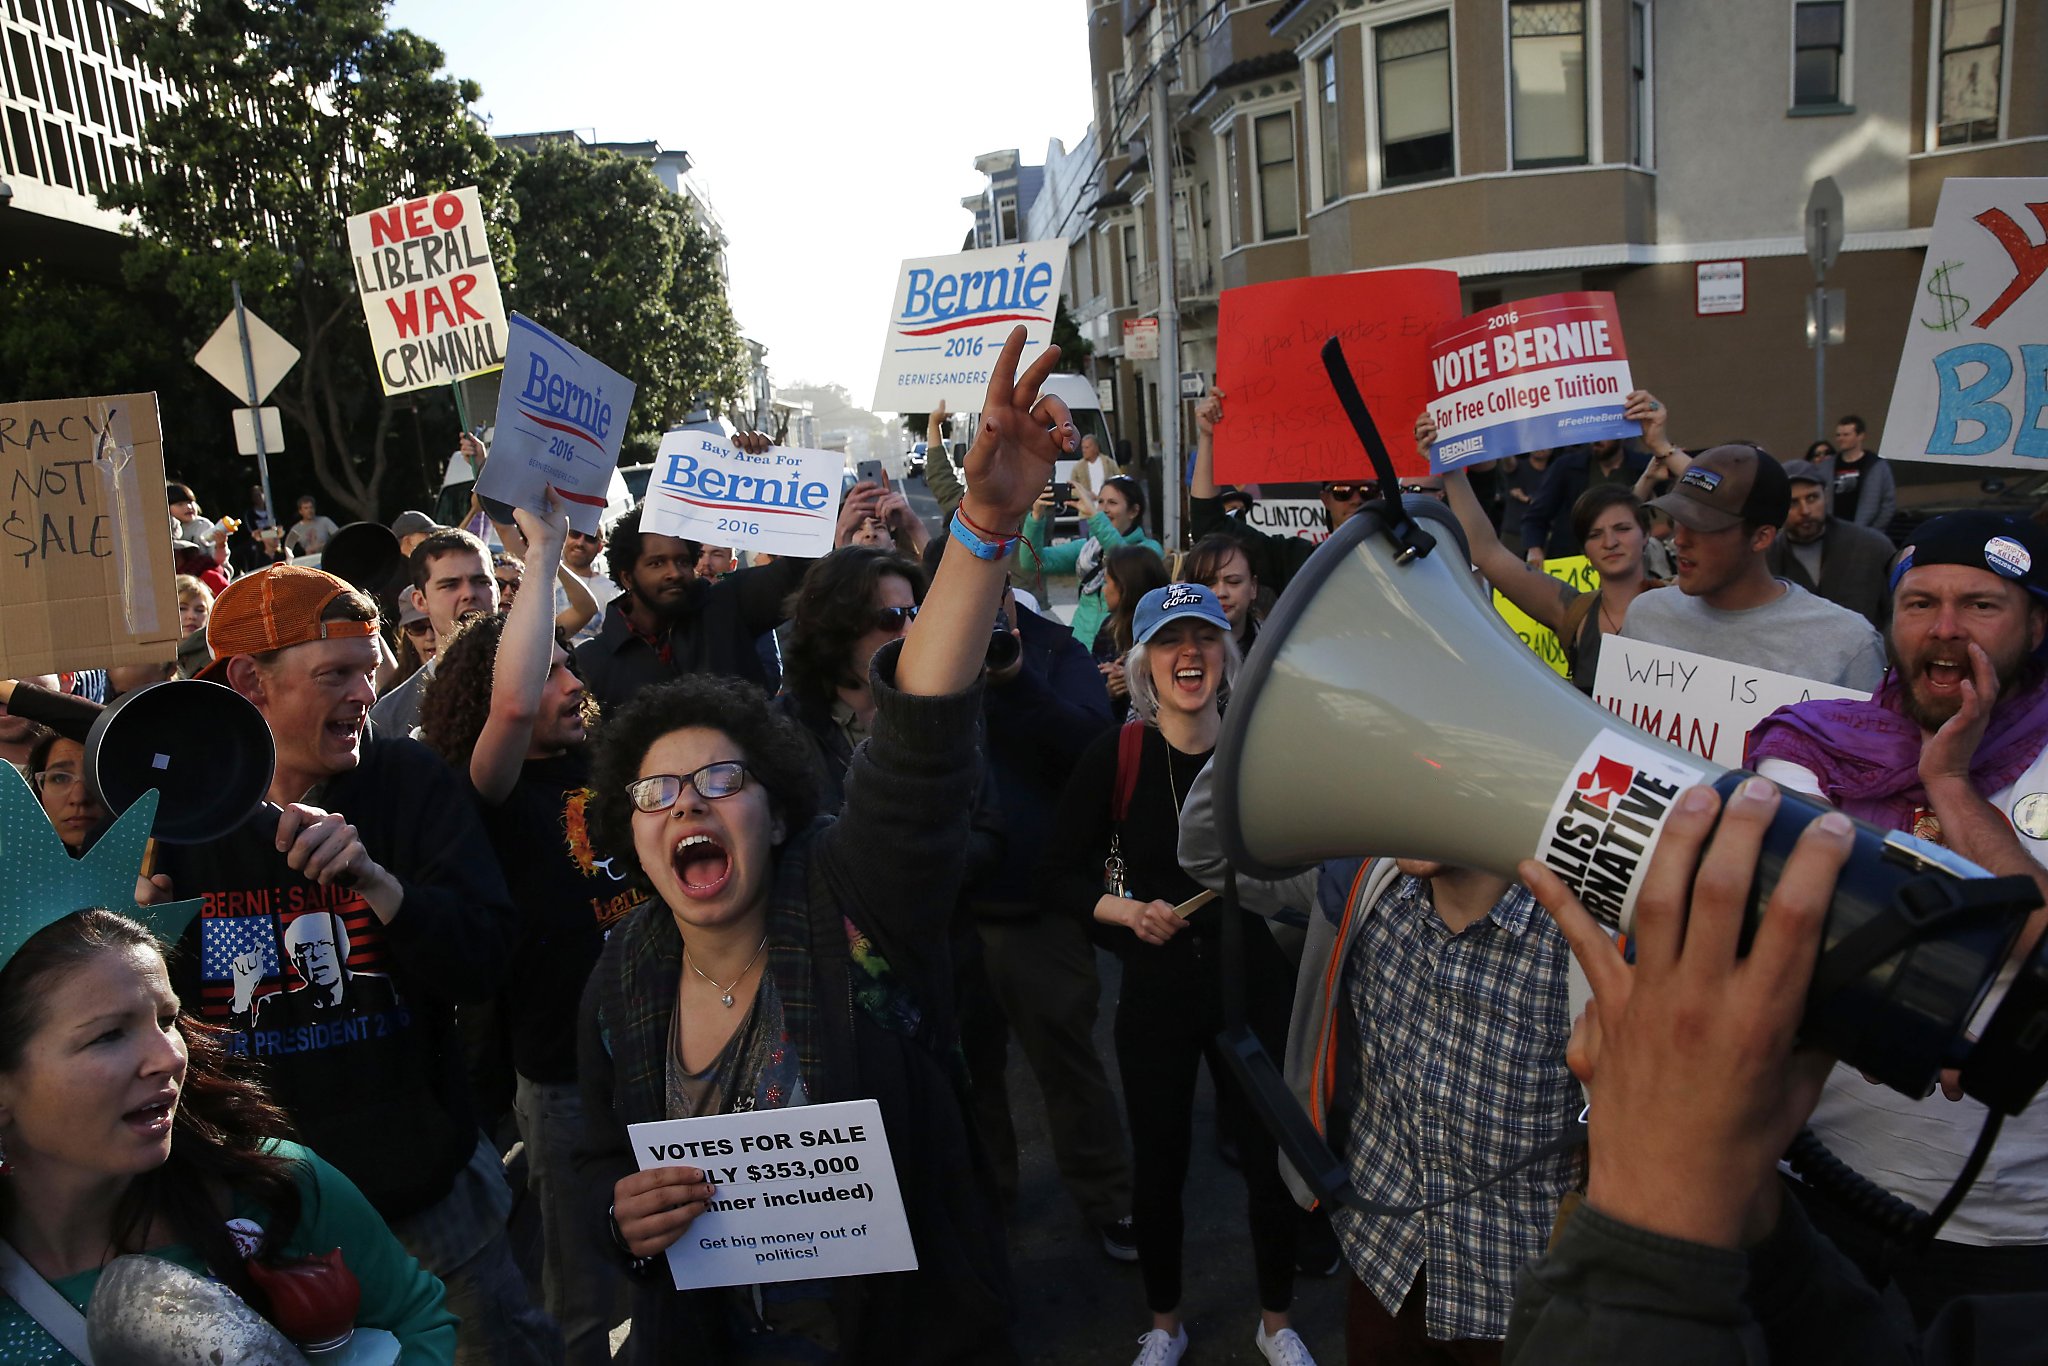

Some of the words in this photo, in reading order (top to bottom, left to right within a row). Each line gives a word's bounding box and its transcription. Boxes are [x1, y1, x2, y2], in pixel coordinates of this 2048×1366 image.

[369, 193, 464, 248] NEO
[355, 226, 489, 295] LIBERAL
[901, 250, 1052, 318] Bernie
[385, 274, 486, 339] WAR
[1487, 311, 1519, 331] 2016
[382, 322, 505, 388] CRIMINAL
[944, 336, 984, 357] 2016
[1432, 340, 1490, 393] VOTE
[1493, 320, 1613, 373] BERNIE
[898, 371, 989, 386] BERNIESANDERS.
[522, 351, 612, 440] Bernie
[1436, 408, 1454, 431] For
[1456, 401, 1485, 424] Free
[1487, 383, 1551, 414] College
[1555, 373, 1619, 400] Tuition
[1557, 412, 1623, 428] #FeeltheBern
[548, 436, 575, 462] 2016
[701, 440, 729, 458] Bay
[735, 451, 770, 465] Area
[776, 455, 803, 466] For
[1439, 435, 1484, 460] BERNIE!
[12, 460, 92, 505] NOT
[662, 454, 829, 510] Bernie
[717, 518, 759, 535] 2016
[1250, 502, 1326, 527] CLINTON
[1997, 549, 2020, 565] KILLER
[1168, 587, 1191, 598] THE
[1625, 653, 1698, 692] WHY
[1730, 675, 1758, 704] IS
[1583, 770, 1680, 929] ERNATIVE
[254, 1016, 369, 1057] PRESIDENT
[648, 1138, 734, 1162] VOTES
[740, 1133, 794, 1153] FOR
[800, 1125, 867, 1148] SALE
[702, 1167, 738, 1185] LY
[747, 1155, 860, 1184] $353,000
[706, 1196, 756, 1213] nner
[763, 1182, 874, 1208] included)
[699, 1237, 728, 1251] Get
[731, 1235, 757, 1250] big
[760, 1230, 815, 1246] money
[819, 1226, 847, 1240] out
[851, 1224, 868, 1238] of
[755, 1246, 819, 1266] politics!
